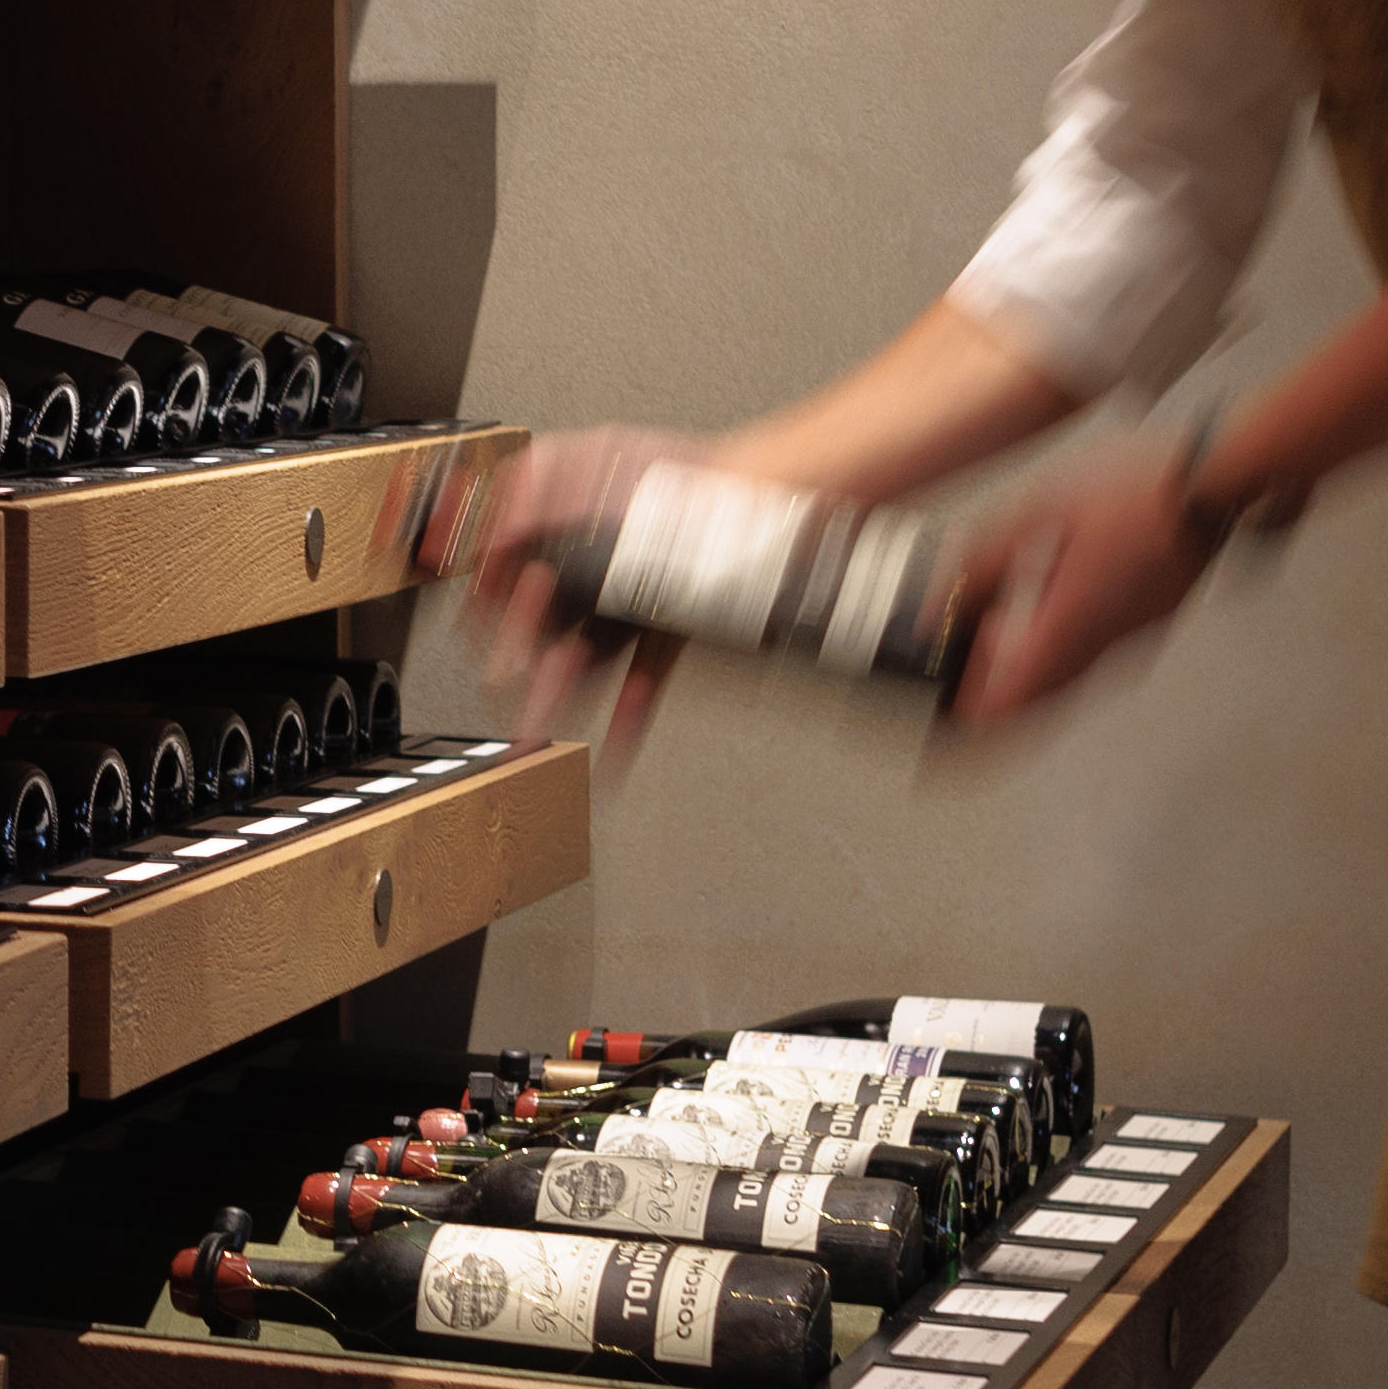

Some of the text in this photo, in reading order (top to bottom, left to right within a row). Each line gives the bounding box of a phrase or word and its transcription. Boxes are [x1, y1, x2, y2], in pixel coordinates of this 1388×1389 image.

[783, 1173, 810, 1227] COSEC
[621, 1241, 670, 1321] TONDO
[675, 1258, 709, 1340] COSECHA
